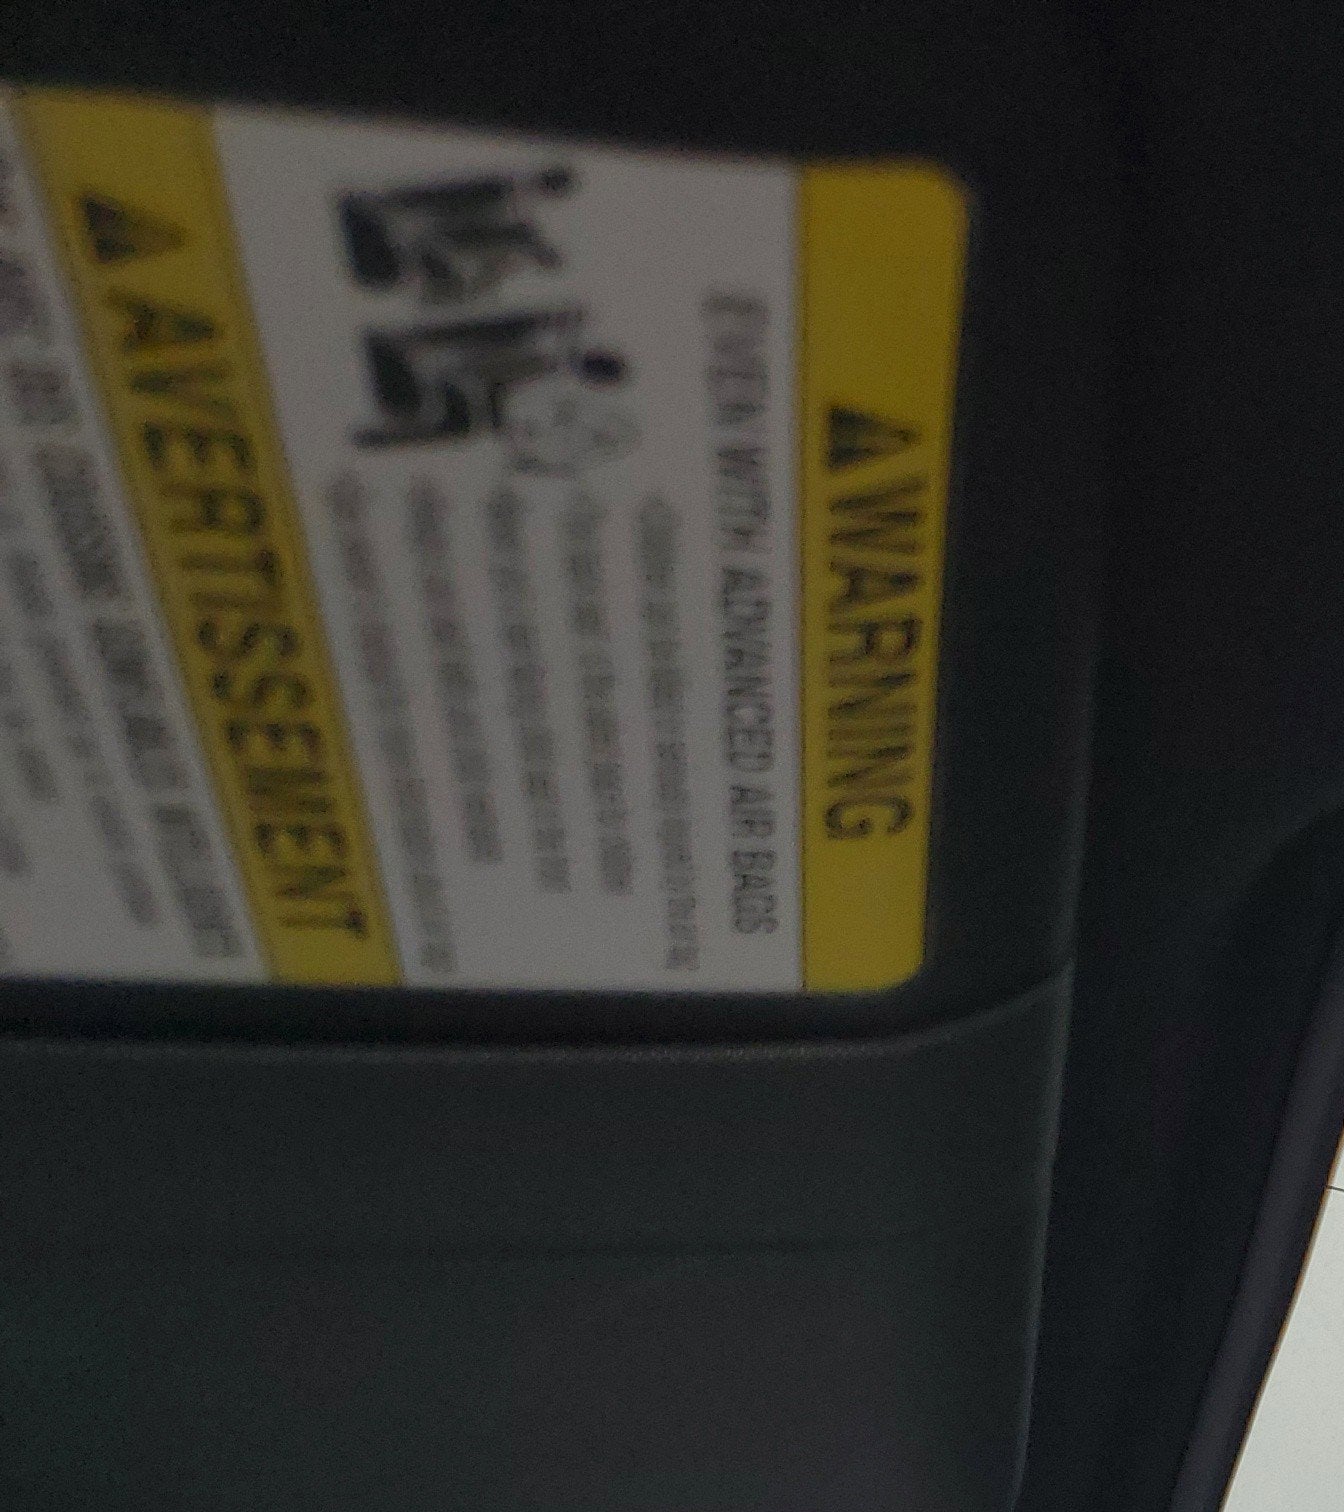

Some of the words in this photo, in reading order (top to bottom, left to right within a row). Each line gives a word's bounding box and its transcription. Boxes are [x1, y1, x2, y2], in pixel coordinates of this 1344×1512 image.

[715, 440, 771, 556] WITH
[120, 291, 370, 941] AVERTISSEMENT
[722, 563, 777, 772] ADVANCED
[826, 480, 925, 843] WARNING
[728, 783, 775, 839] AIR
[734, 849, 777, 937] BAGS
